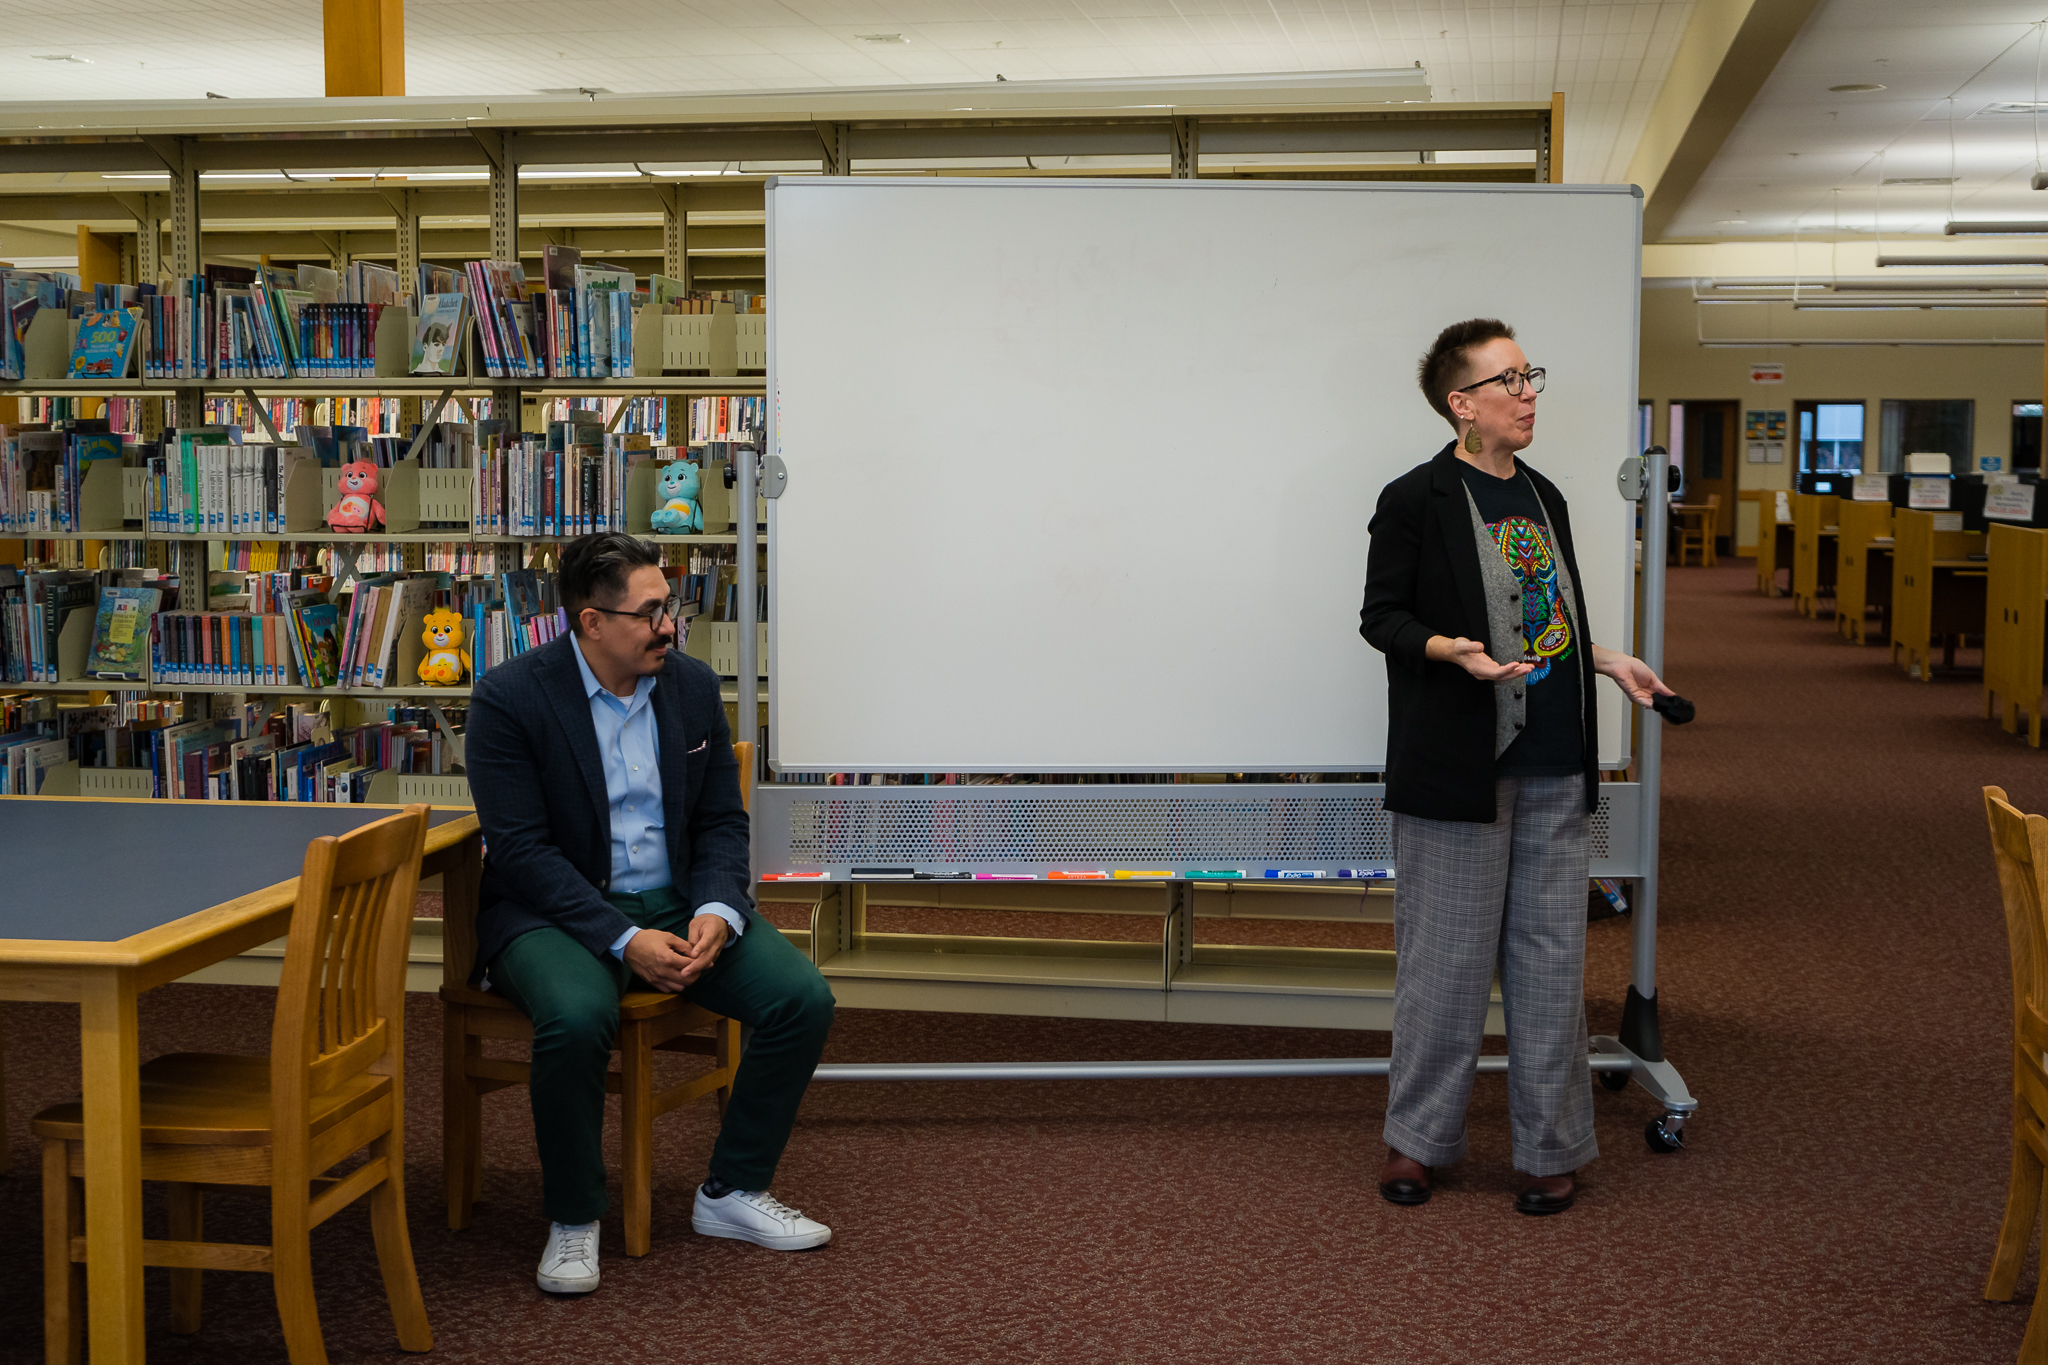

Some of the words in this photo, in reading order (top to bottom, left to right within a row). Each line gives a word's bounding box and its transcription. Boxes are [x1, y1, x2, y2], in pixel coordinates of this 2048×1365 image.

[90, 331, 117, 344] 500
[58, 588, 91, 602] HOBBIT
[312, 618, 321, 626] AM
